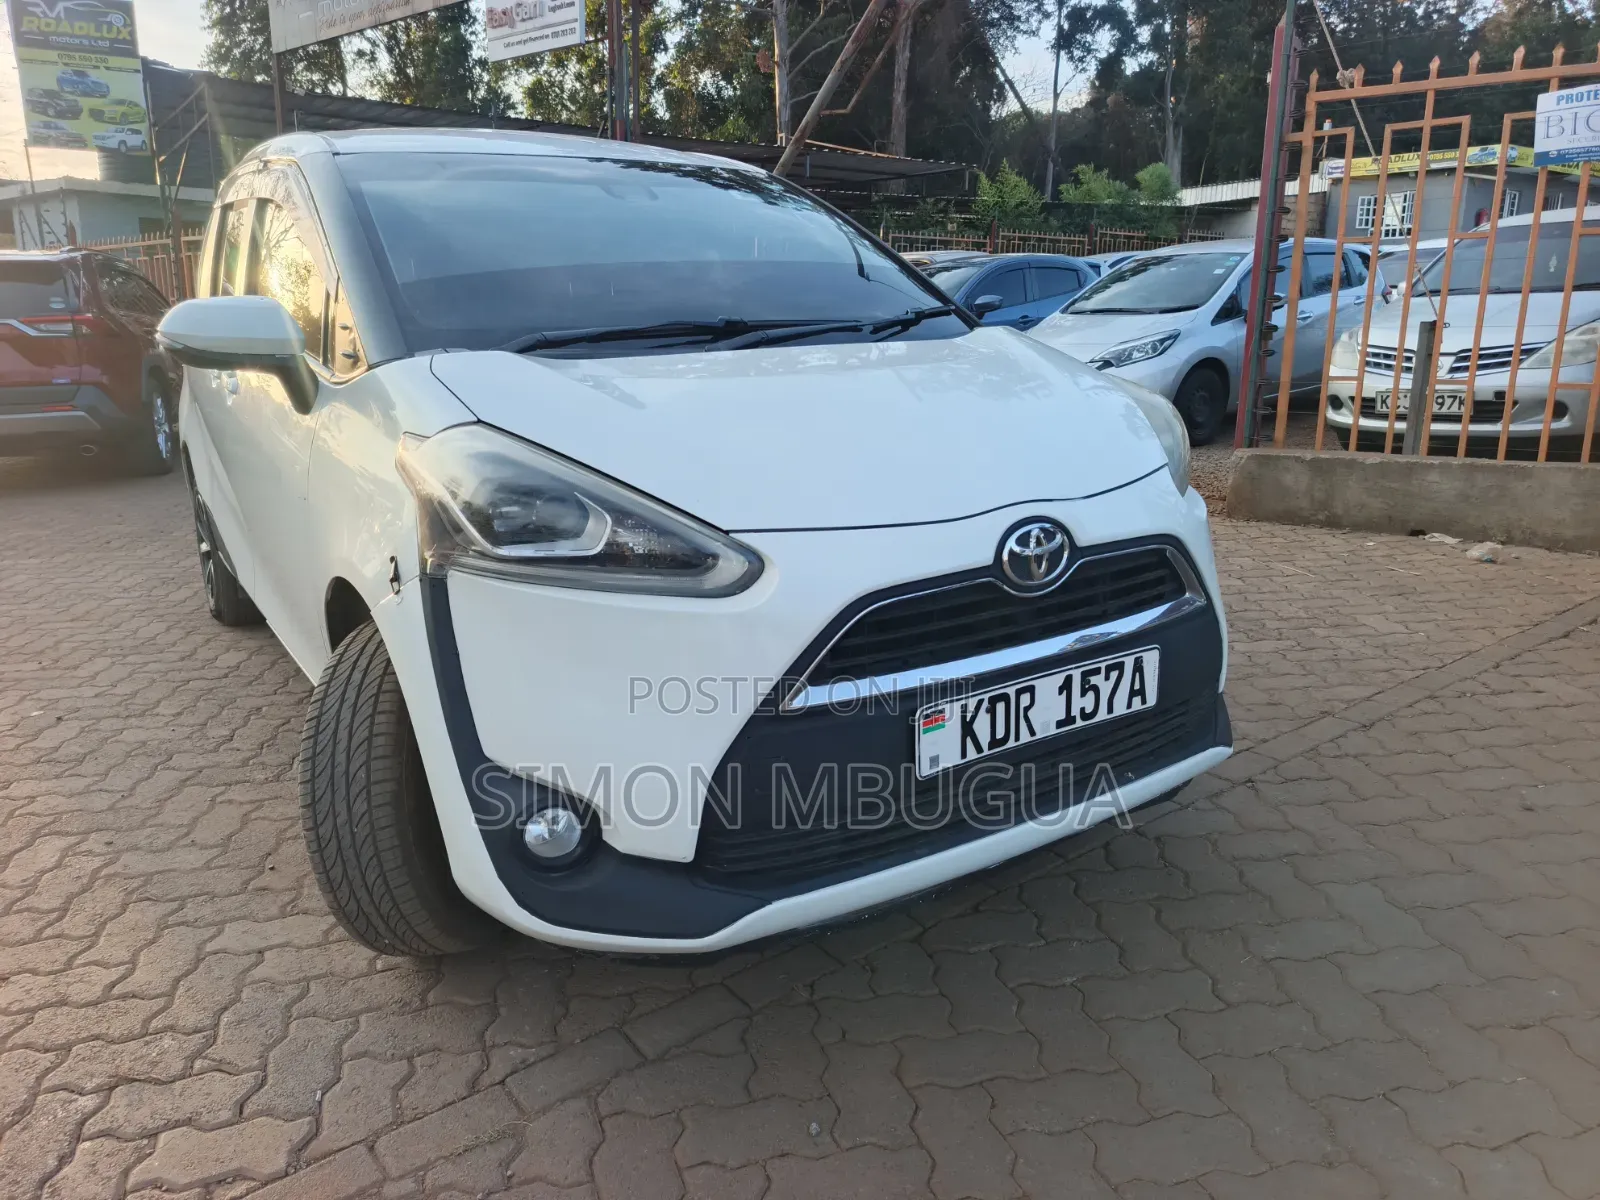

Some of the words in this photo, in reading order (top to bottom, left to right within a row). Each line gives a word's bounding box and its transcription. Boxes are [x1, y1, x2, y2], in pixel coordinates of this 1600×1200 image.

[20, 16, 133, 40] ROADLUX
[49, 36, 89, 46] motors
[91, 39, 110, 47] Ltd
[1434, 394, 1466, 411] 97K
[960, 684, 1037, 760] KDR
[1055, 655, 1147, 729] 157A
